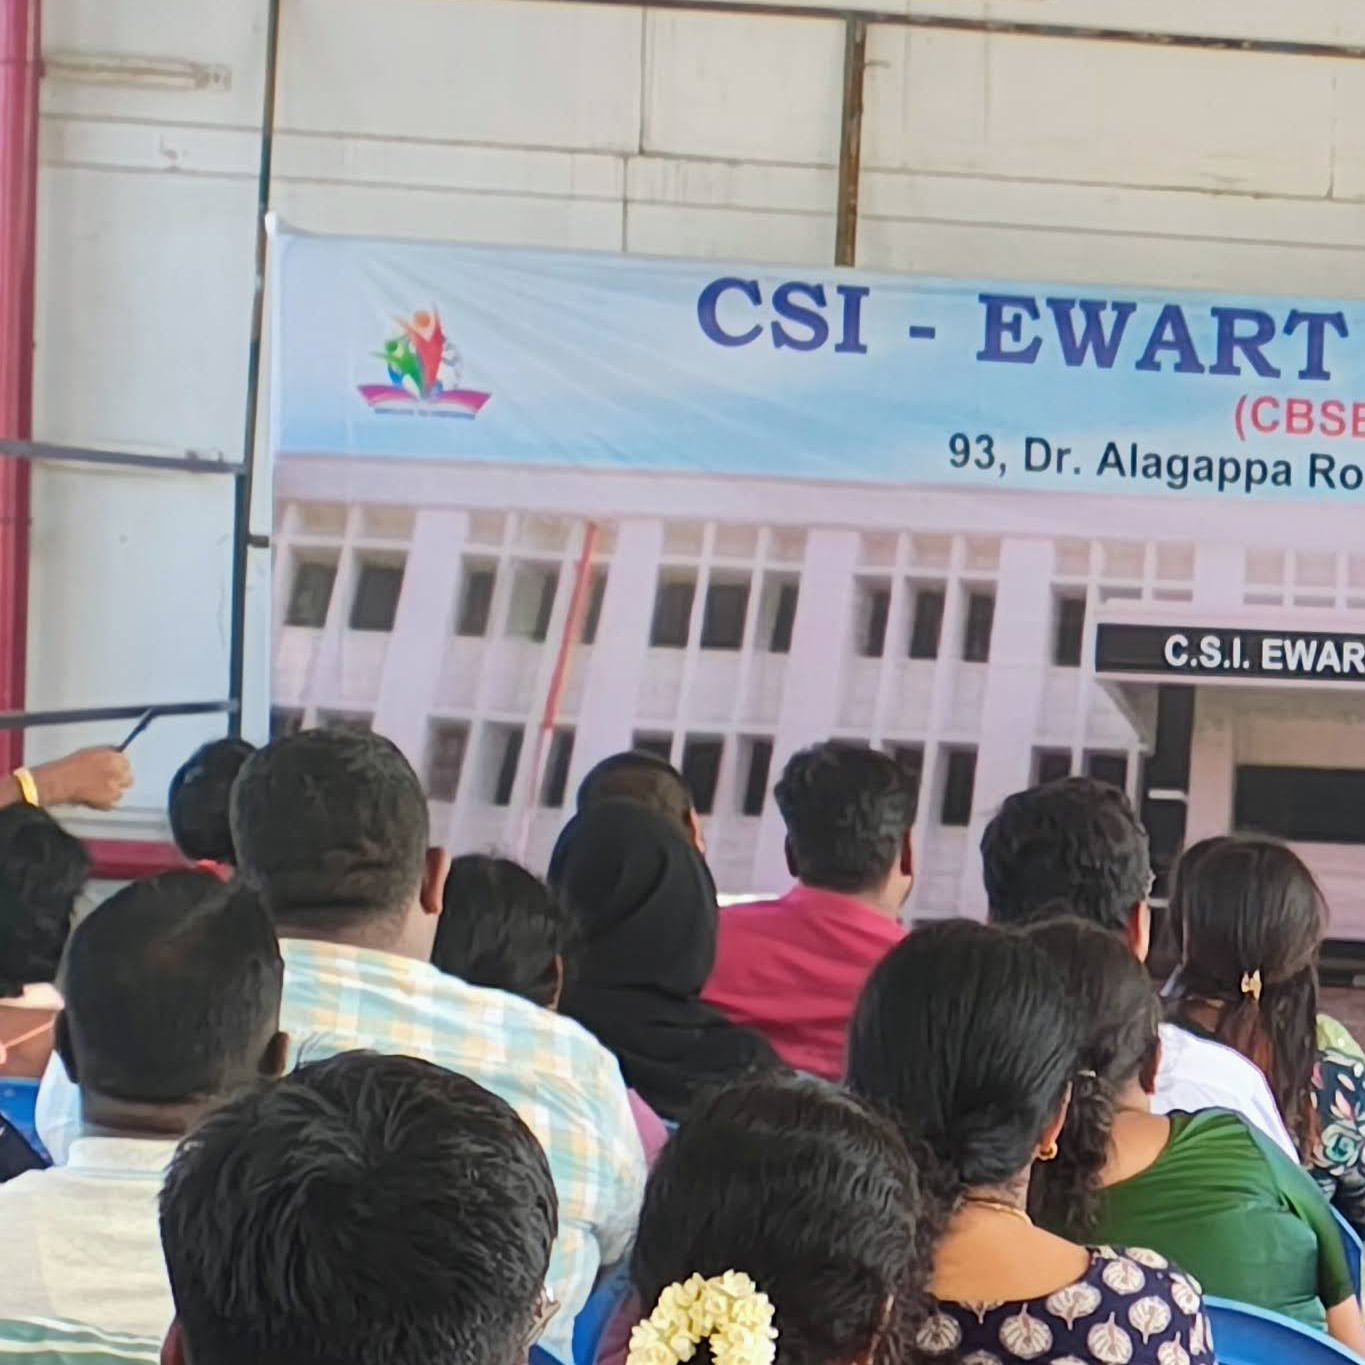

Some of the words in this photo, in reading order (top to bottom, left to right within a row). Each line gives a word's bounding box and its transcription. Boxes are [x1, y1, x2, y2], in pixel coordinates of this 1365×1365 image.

[697, 276, 870, 354] CSI
[909, 325, 936, 340] -
[976, 292, 1349, 381] EWART
[949, 432, 1006, 476] 93,
[1024, 437, 1081, 473] Dr.
[1097, 441, 1292, 493] Alagappa
[1164, 633, 1250, 669] C.S.I.
